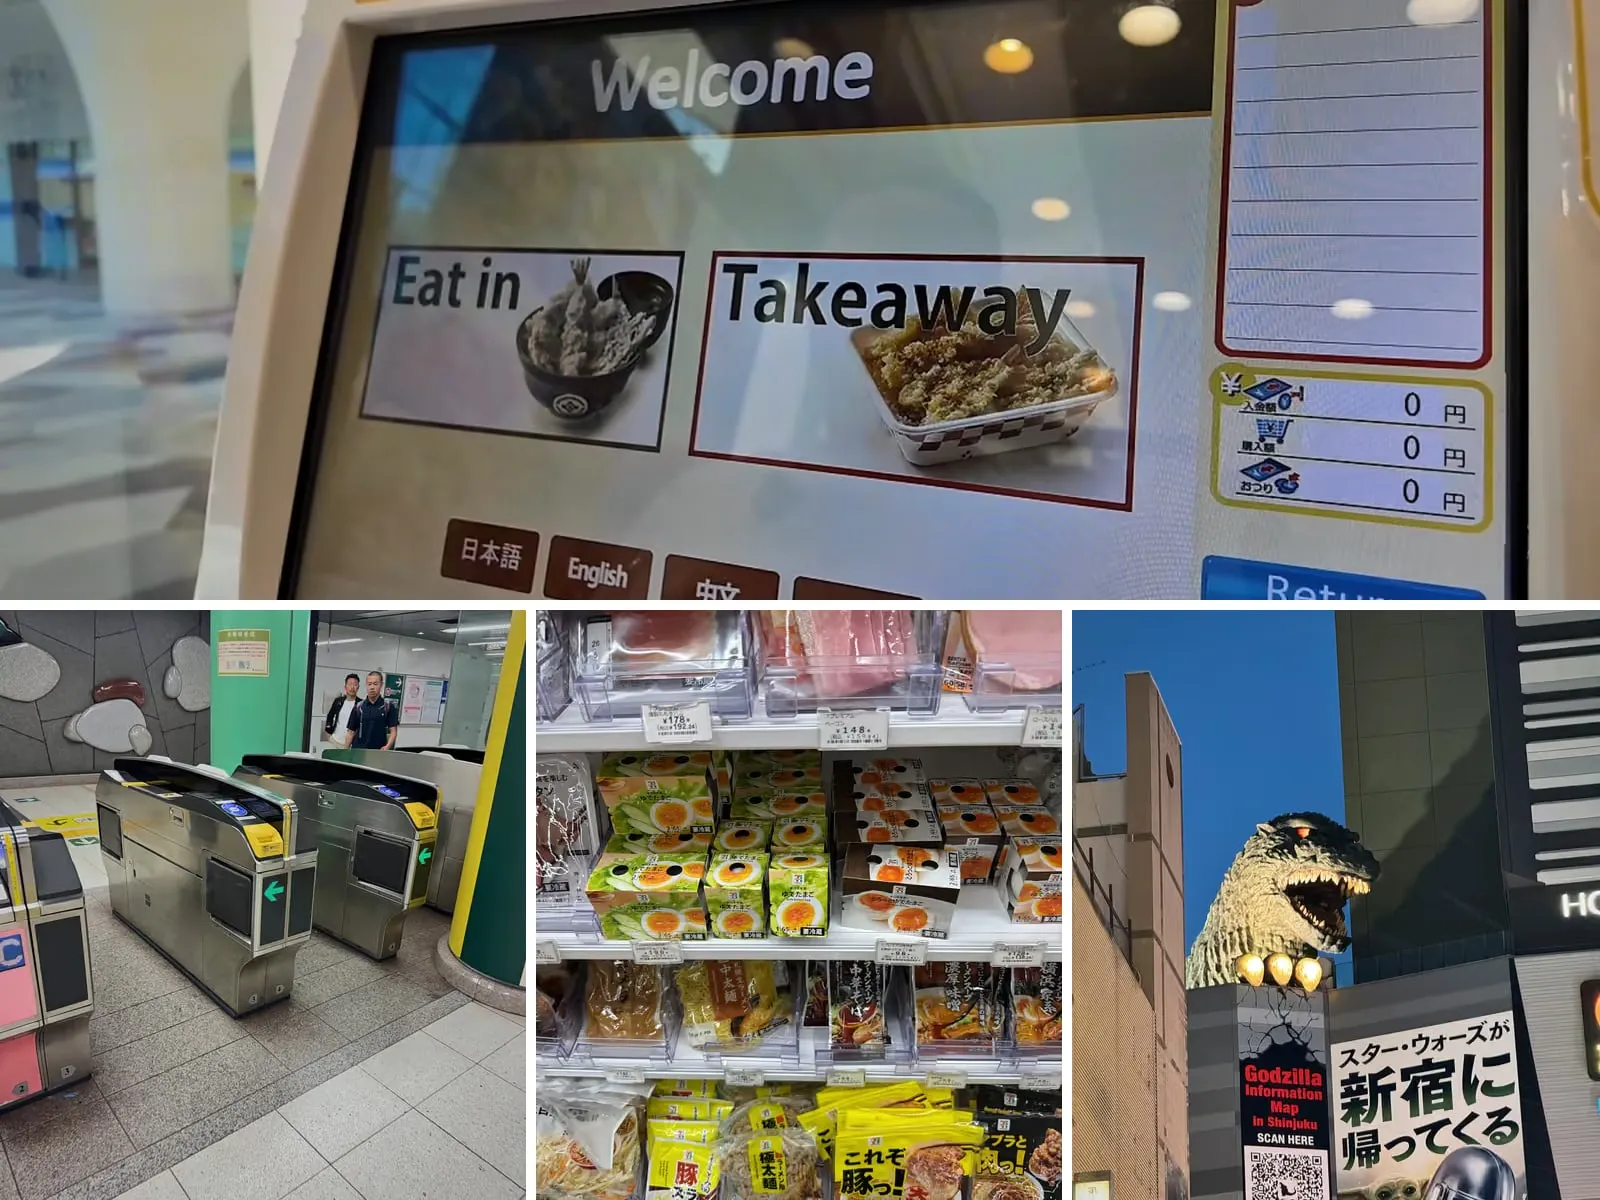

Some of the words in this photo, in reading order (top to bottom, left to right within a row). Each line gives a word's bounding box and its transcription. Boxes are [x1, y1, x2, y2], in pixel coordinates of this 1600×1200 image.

[592, 49, 873, 112] Welcome
[393, 256, 466, 308] Eat
[476, 257, 521, 310] in
[722, 263, 1071, 357] Takeaway
[1404, 392, 1420, 416] 0
[1444, 404, 1466, 424] 円
[1404, 435, 1420, 460] 0
[1444, 448, 1466, 468] 円
[1240, 480, 1273, 494] おつり
[1403, 478, 1419, 503] 0
[1444, 492, 1465, 512] 円
[461, 537, 522, 571] 日本語
[568, 557, 628, 589] English
[850, 963, 864, 1022] 中華そば
[964, 961, 973, 1002] ーメンスープ
[1339, 1021, 1511, 1070] スター・ウォーズが
[64, 1067, 70, 1075] 3
[1244, 1064, 1323, 1086] Godzilla
[19, 1085, 25, 1093] 2
[1245, 1084, 1323, 1100] Information
[1340, 1053, 1516, 1128] 新宿に
[1252, 1115, 1264, 1127] in
[1267, 1116, 1318, 1130] Shinjuku
[1271, 1101, 1299, 1115] Map
[1257, 1132, 1286, 1144] SCAN
[1288, 1134, 1315, 1146] HERE
[1342, 1105, 1520, 1171] 帰ってくる
[760, 1152, 777, 1190] 極太麺
[844, 1148, 906, 1166] これぞ
[675, 1161, 699, 1187] 豚
[841, 1168, 906, 1196] 豚っ!
